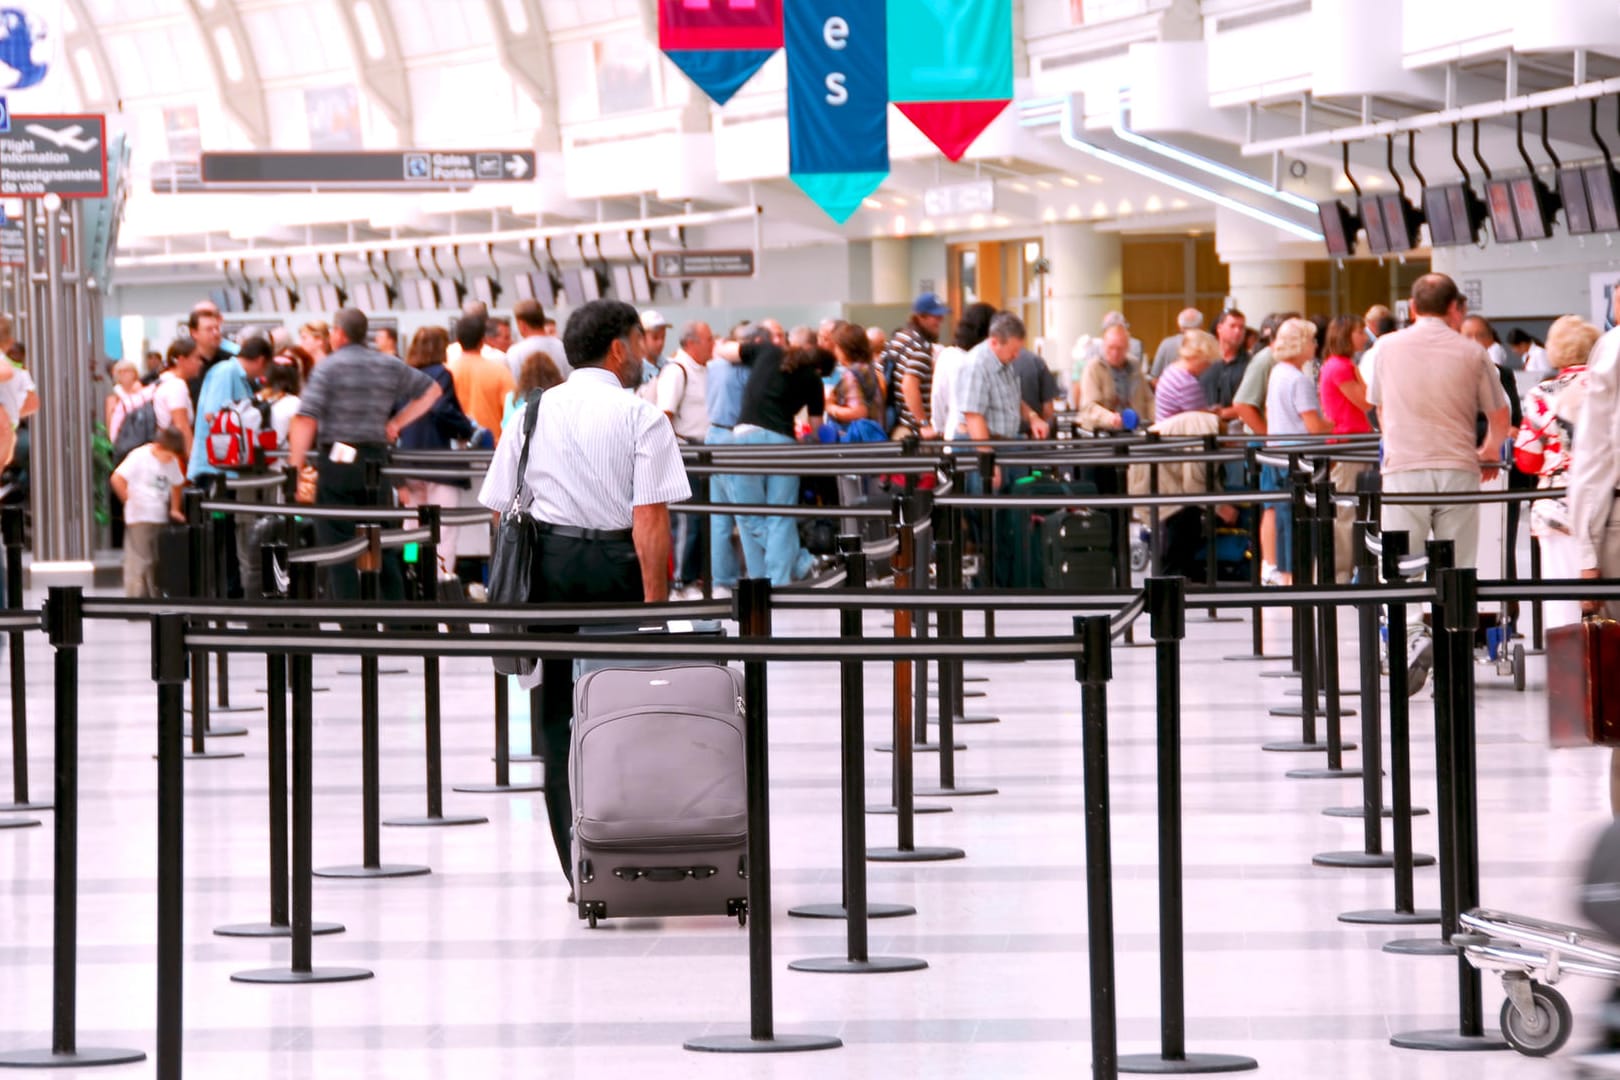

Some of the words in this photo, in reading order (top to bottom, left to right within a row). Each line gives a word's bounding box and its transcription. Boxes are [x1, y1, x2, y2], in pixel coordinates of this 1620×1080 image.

[0, 138, 35, 153] Flight
[1, 168, 101, 184] Renseignements
[2, 181, 17, 193] de
